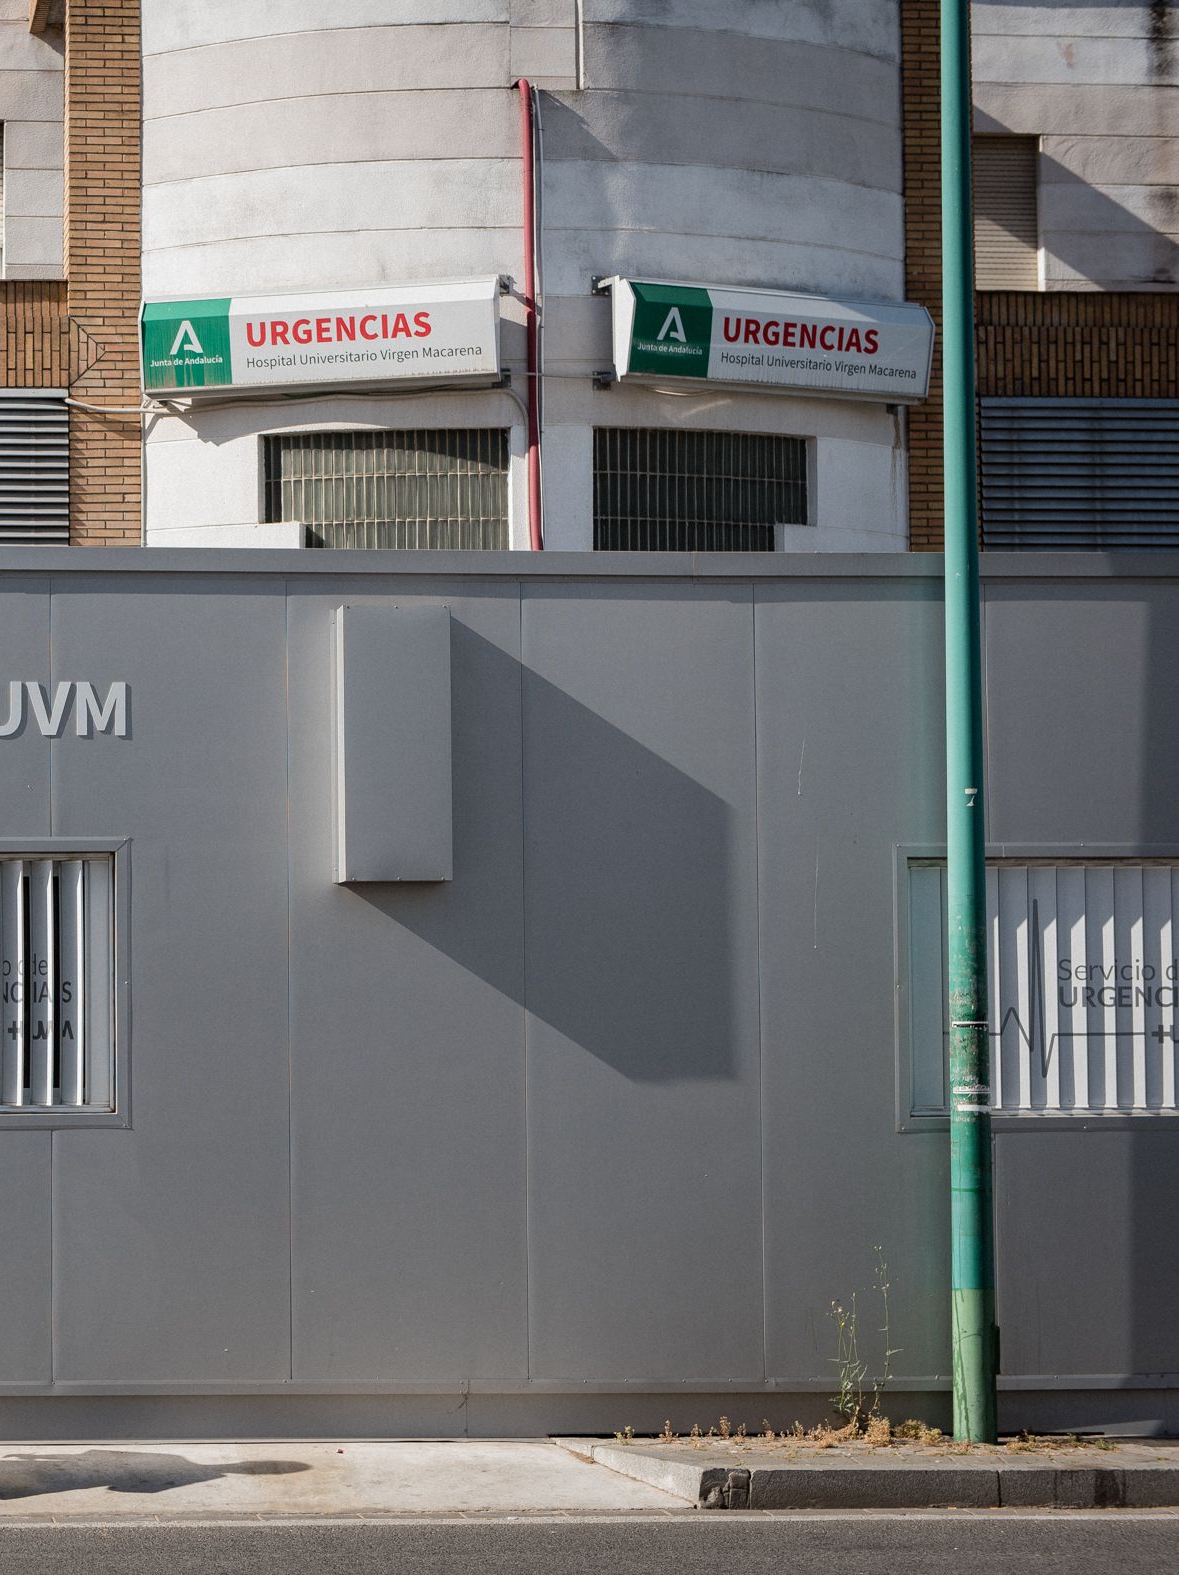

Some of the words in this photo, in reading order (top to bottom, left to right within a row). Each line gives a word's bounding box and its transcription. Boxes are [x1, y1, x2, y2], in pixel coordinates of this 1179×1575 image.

[245, 311, 432, 348] URGENCIAS
[723, 316, 880, 355] URGENCIAS
[246, 354, 297, 370] Hospital
[299, 350, 377, 366] Universitario
[380, 348, 419, 364] Virgen
[422, 345, 482, 359] Macarena
[637, 341, 657, 351] Junta
[658, 344, 668, 352] de
[668, 345, 703, 355] Andalucía
[150, 359, 172, 367] Junta
[184, 355, 223, 365] Andalucía
[721, 352, 764, 367] Hospital
[766, 356, 832, 372] Universitario
[834, 361, 866, 377] Virgen
[869, 365, 917, 380] Macarena
[1058, 959, 1156, 981] Servicio
